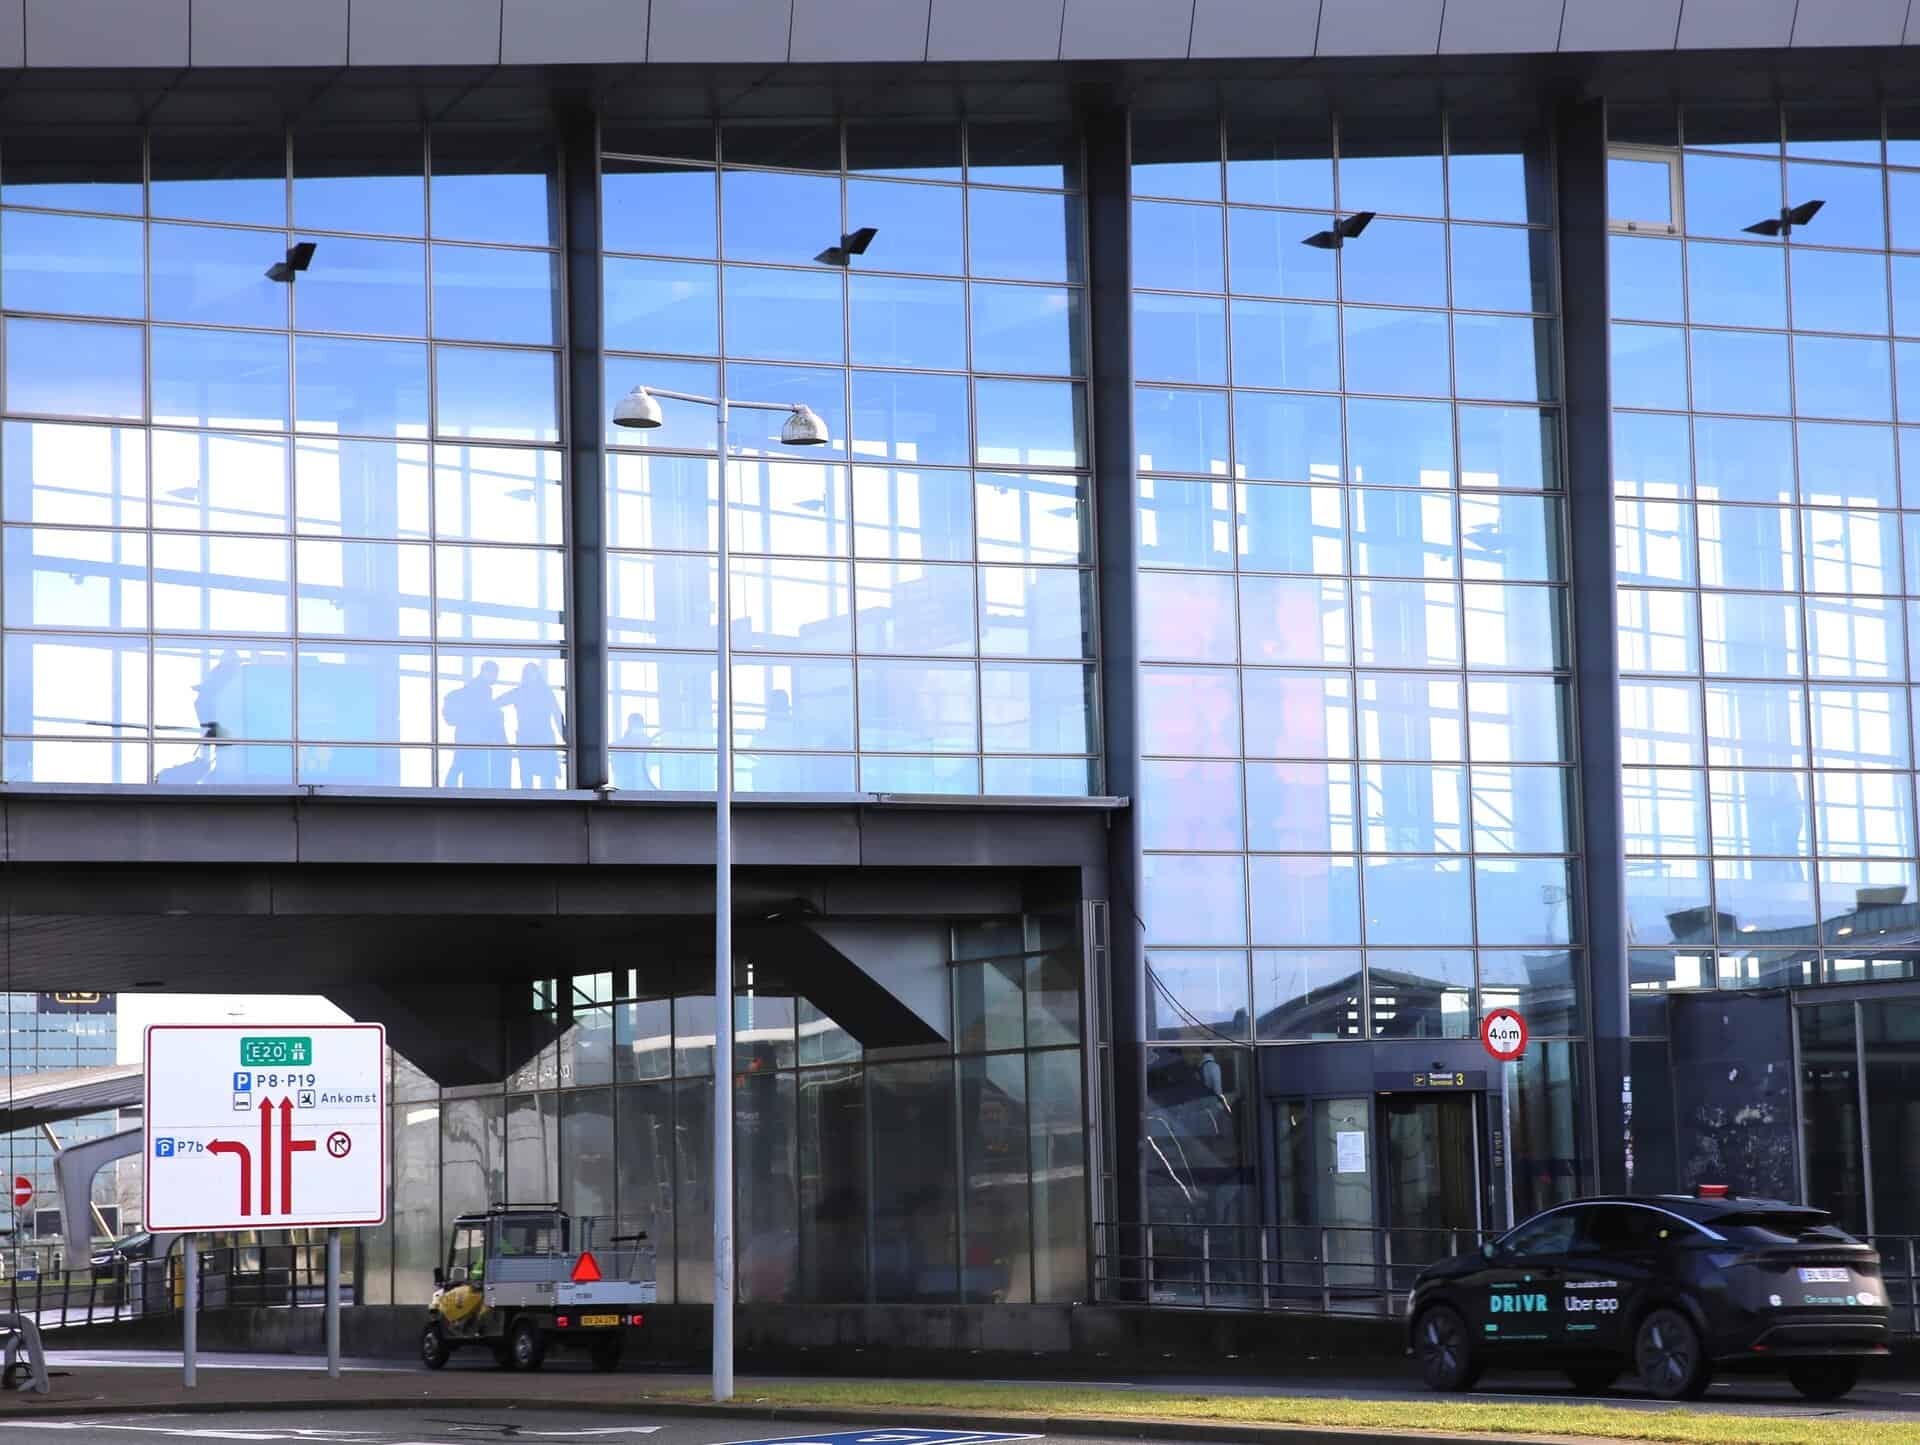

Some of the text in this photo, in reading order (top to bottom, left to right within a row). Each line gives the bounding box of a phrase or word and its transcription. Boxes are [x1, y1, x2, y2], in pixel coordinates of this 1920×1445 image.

[252, 1046, 283, 1058] E20
[1456, 1072, 1464, 1086] 3
[321, 1092, 377, 1104] Ankomst
[177, 1141, 204, 1153] P7b
[1490, 1294, 1549, 1312] DRIVR
[1564, 1295, 1619, 1314] Uber app
